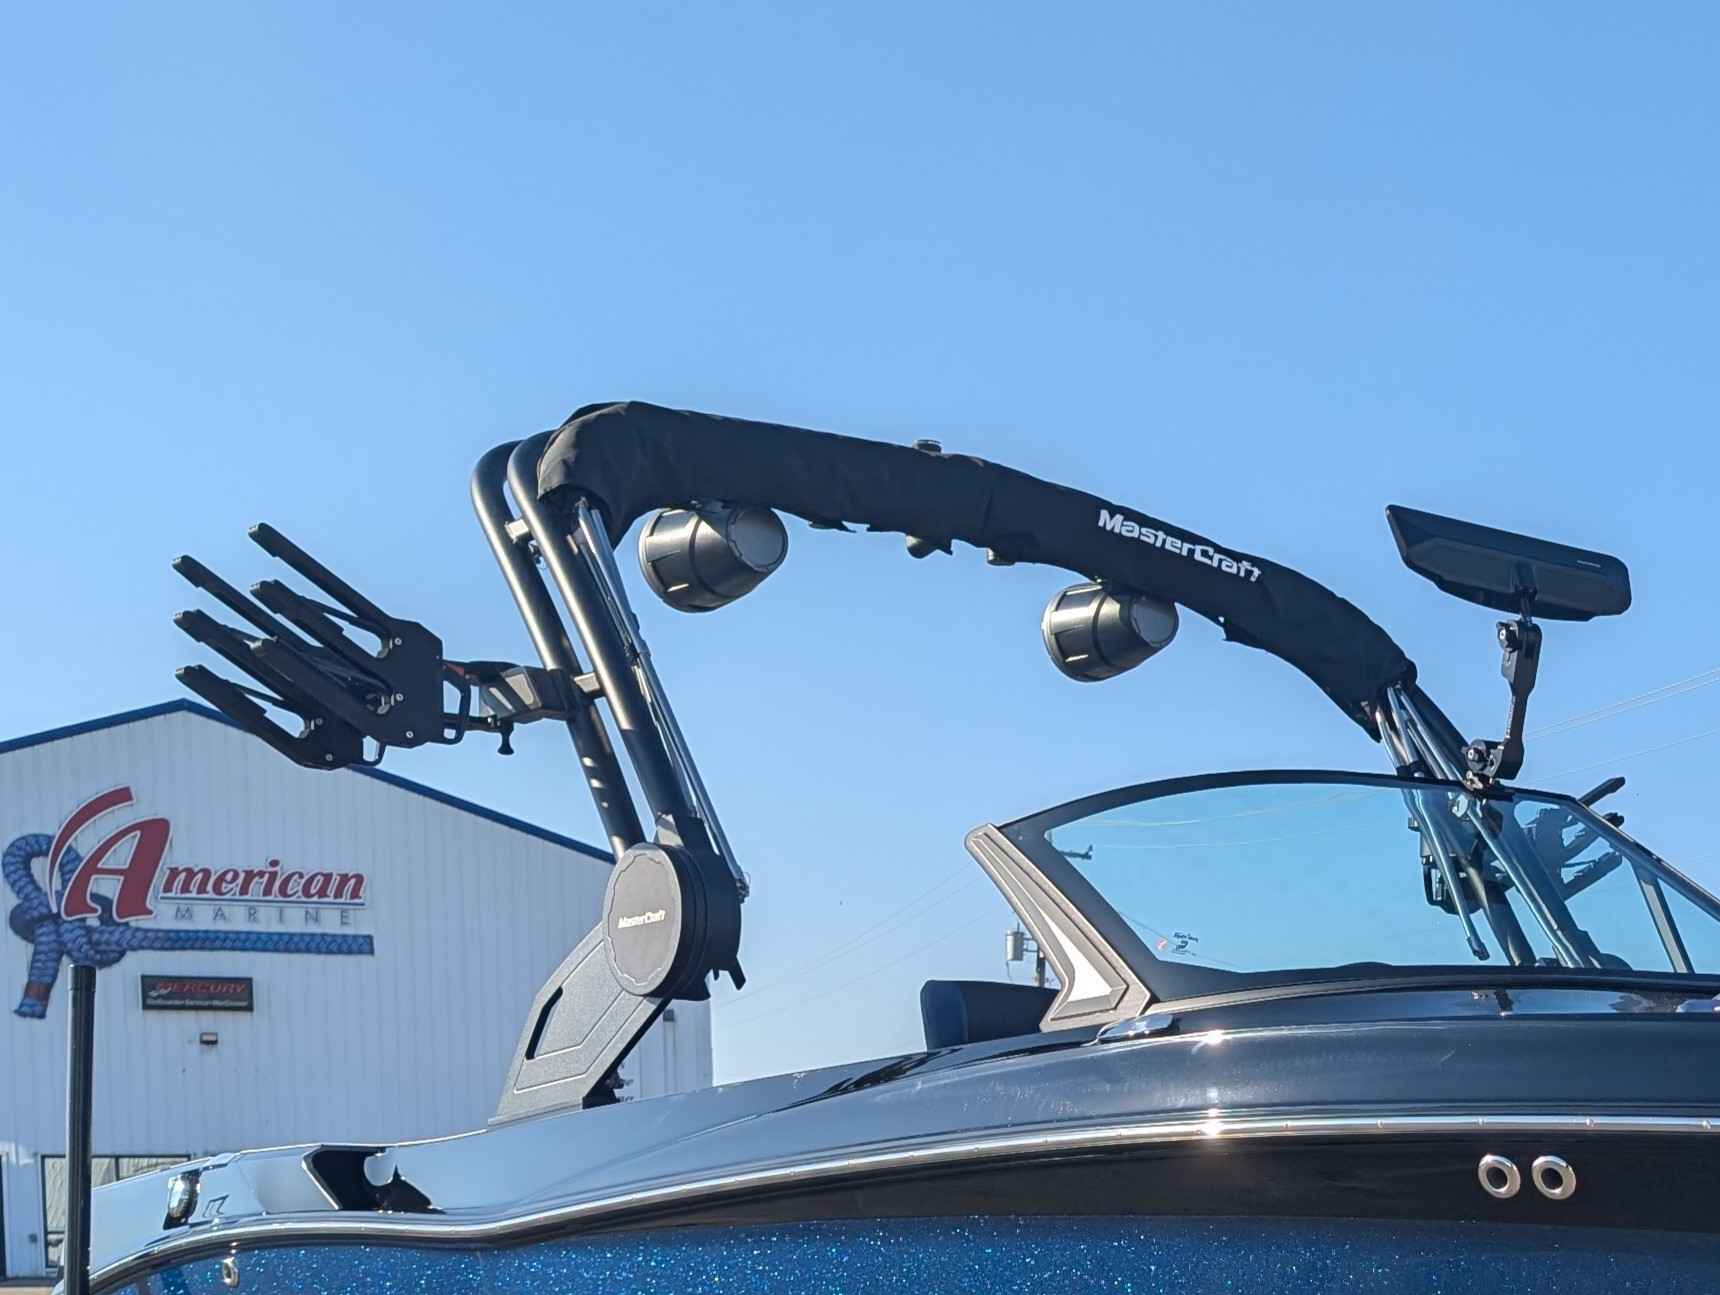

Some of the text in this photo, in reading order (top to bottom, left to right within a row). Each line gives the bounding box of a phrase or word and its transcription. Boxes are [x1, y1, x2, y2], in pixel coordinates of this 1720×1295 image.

[1097, 508, 1262, 583] MasterCraft
[61, 817, 367, 922] American
[174, 904, 354, 926] MARINE
